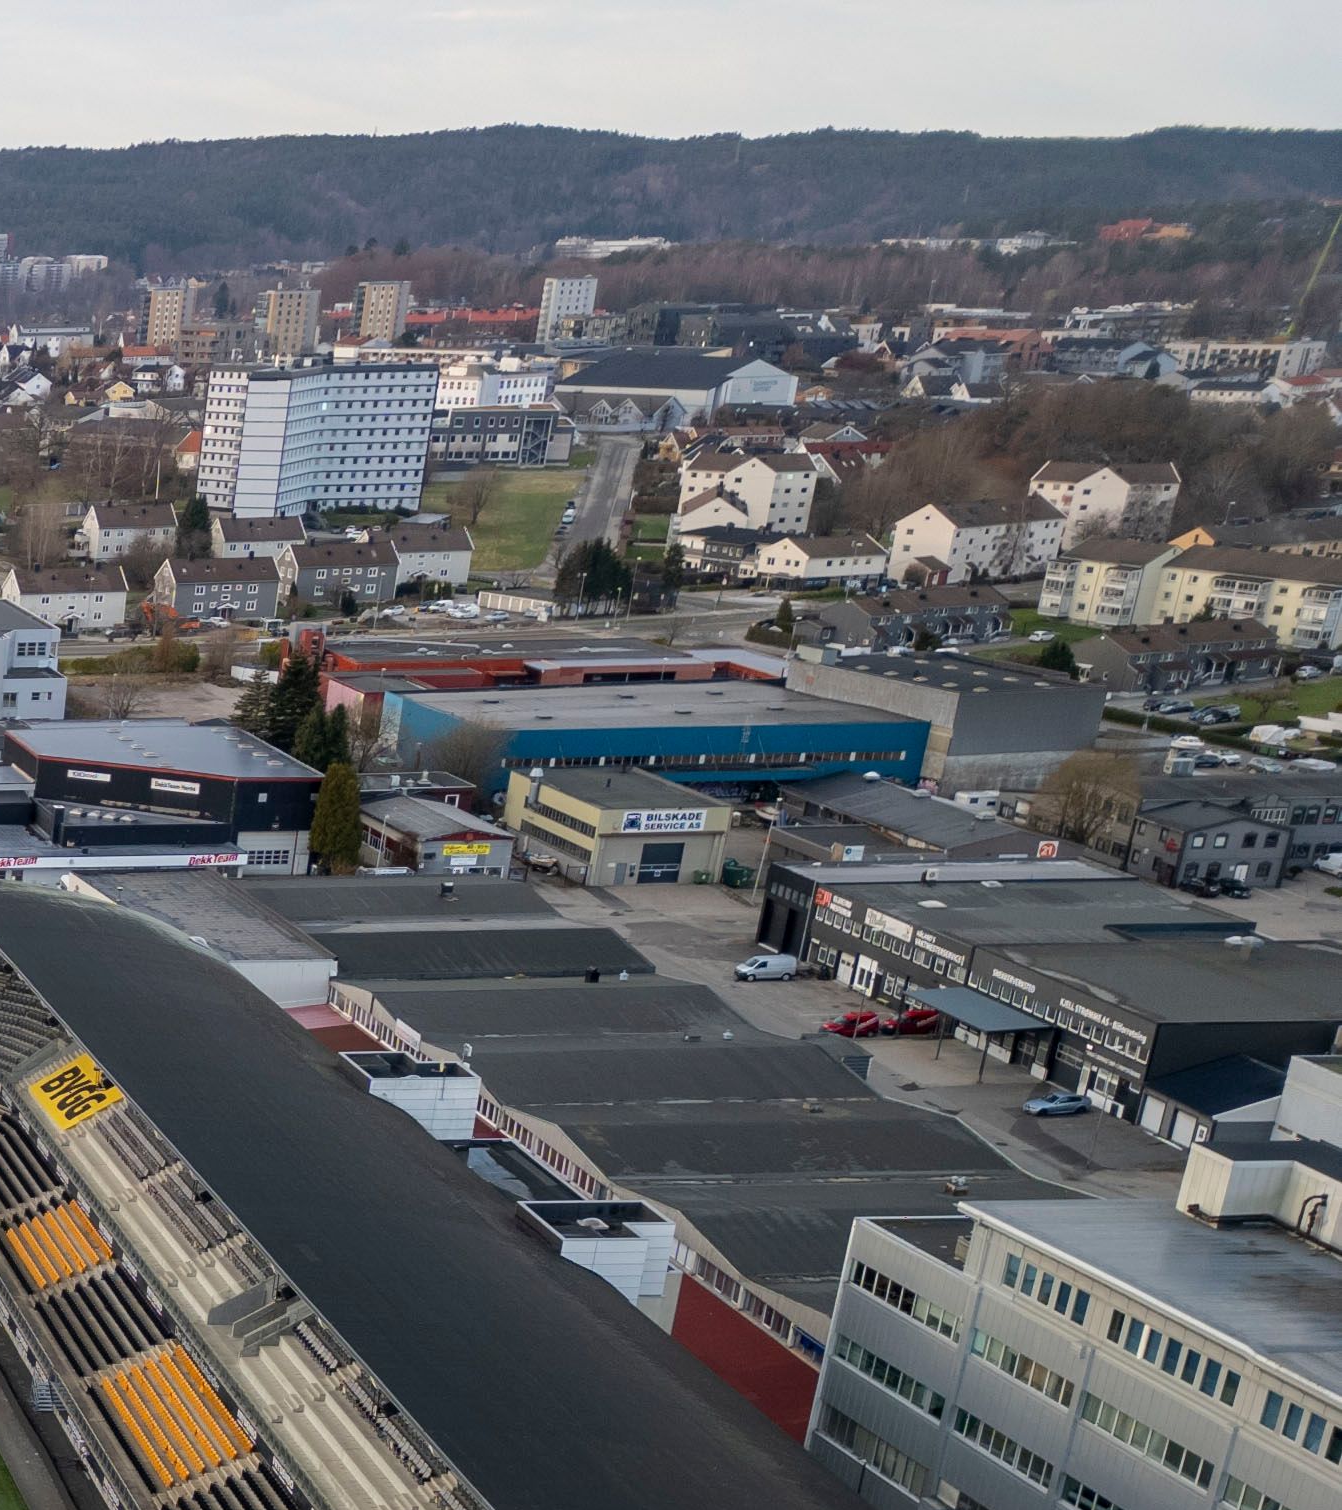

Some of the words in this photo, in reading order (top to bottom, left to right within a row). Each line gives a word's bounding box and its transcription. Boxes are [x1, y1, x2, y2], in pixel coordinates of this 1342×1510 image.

[646, 812, 703, 821] BILSKADE
[644, 822, 685, 830] SERVICE
[1040, 845, 1053, 856] 21
[40, 1065, 107, 1120] BYGG
